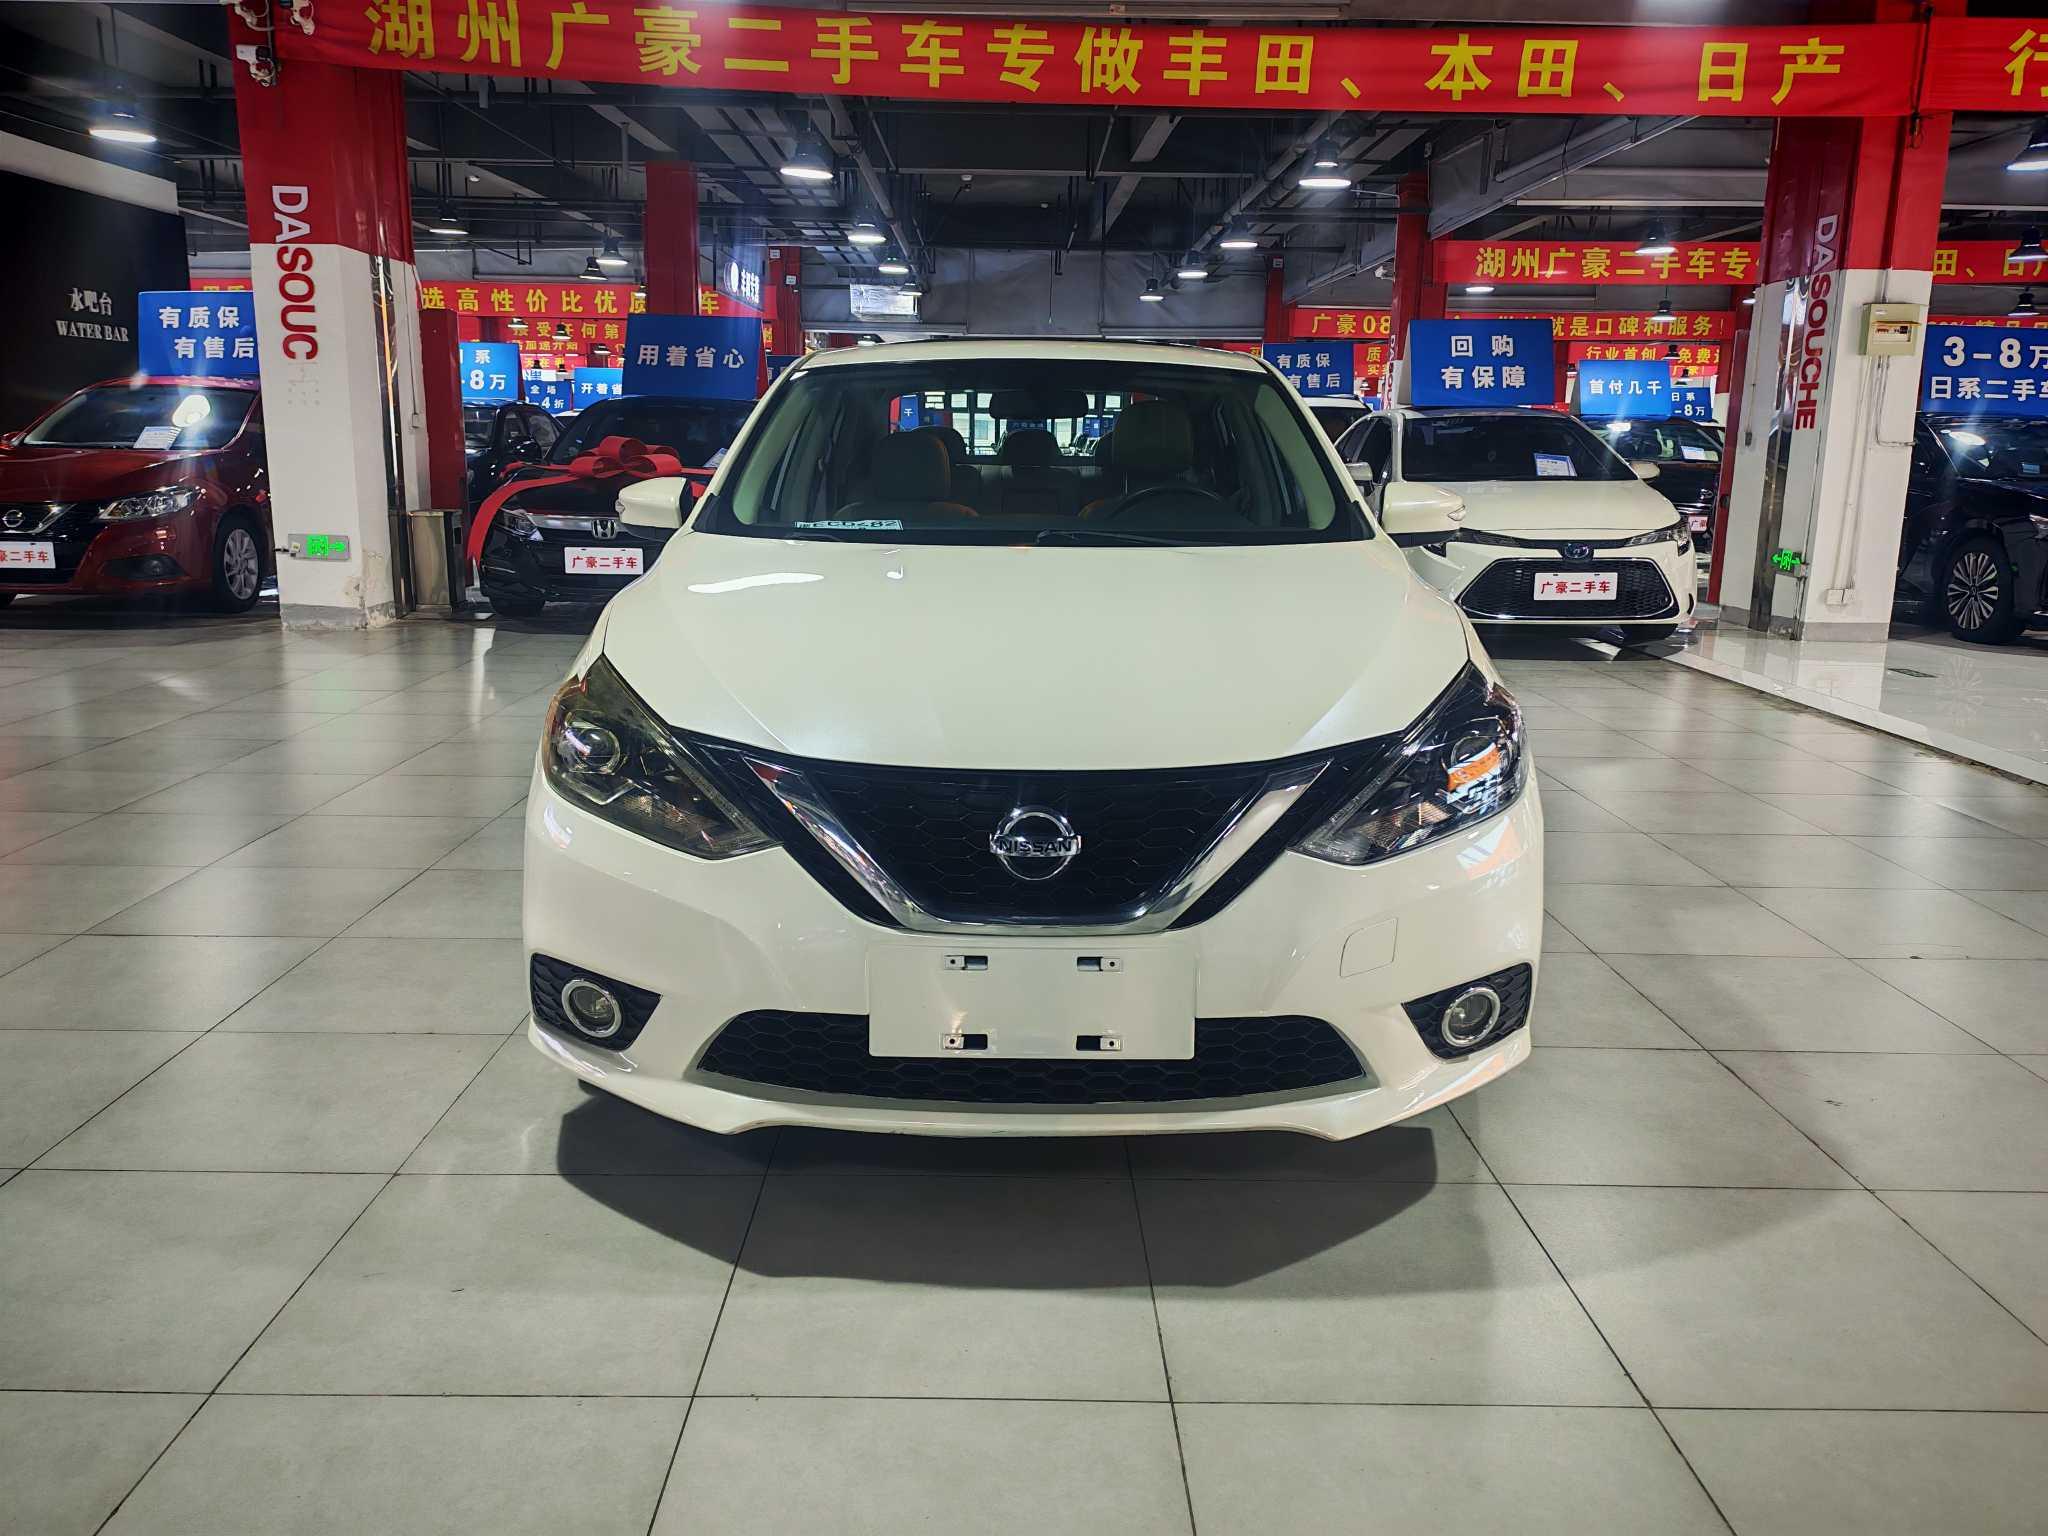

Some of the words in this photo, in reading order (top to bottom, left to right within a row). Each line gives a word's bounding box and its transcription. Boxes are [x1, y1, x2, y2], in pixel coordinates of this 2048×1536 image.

[272, 185, 319, 360] DASOUC
[1475, 246, 1761, 280] 湖州广豪二手车专
[69, 287, 113, 316] 水吧台
[158, 305, 241, 329] 有质保
[1794, 214, 1839, 430] DASOUCHE
[56, 320, 103, 340] WATER
[105, 325, 129, 342] BAR
[174, 335, 255, 360] 有售后
[637, 343, 745, 369] 用着省心
[1450, 335, 1514, 357] 回购
[1277, 353, 1331, 368] 有质保
[1288, 373, 1341, 389] 有售后
[1441, 366, 1526, 389] 有保障
[1589, 380, 1662, 396] 首付几千
[572, 555, 638, 569] 广豪二手车
[1541, 581, 1611, 594] 广豪二手车
[1000, 840, 1072, 853] NISSAN
